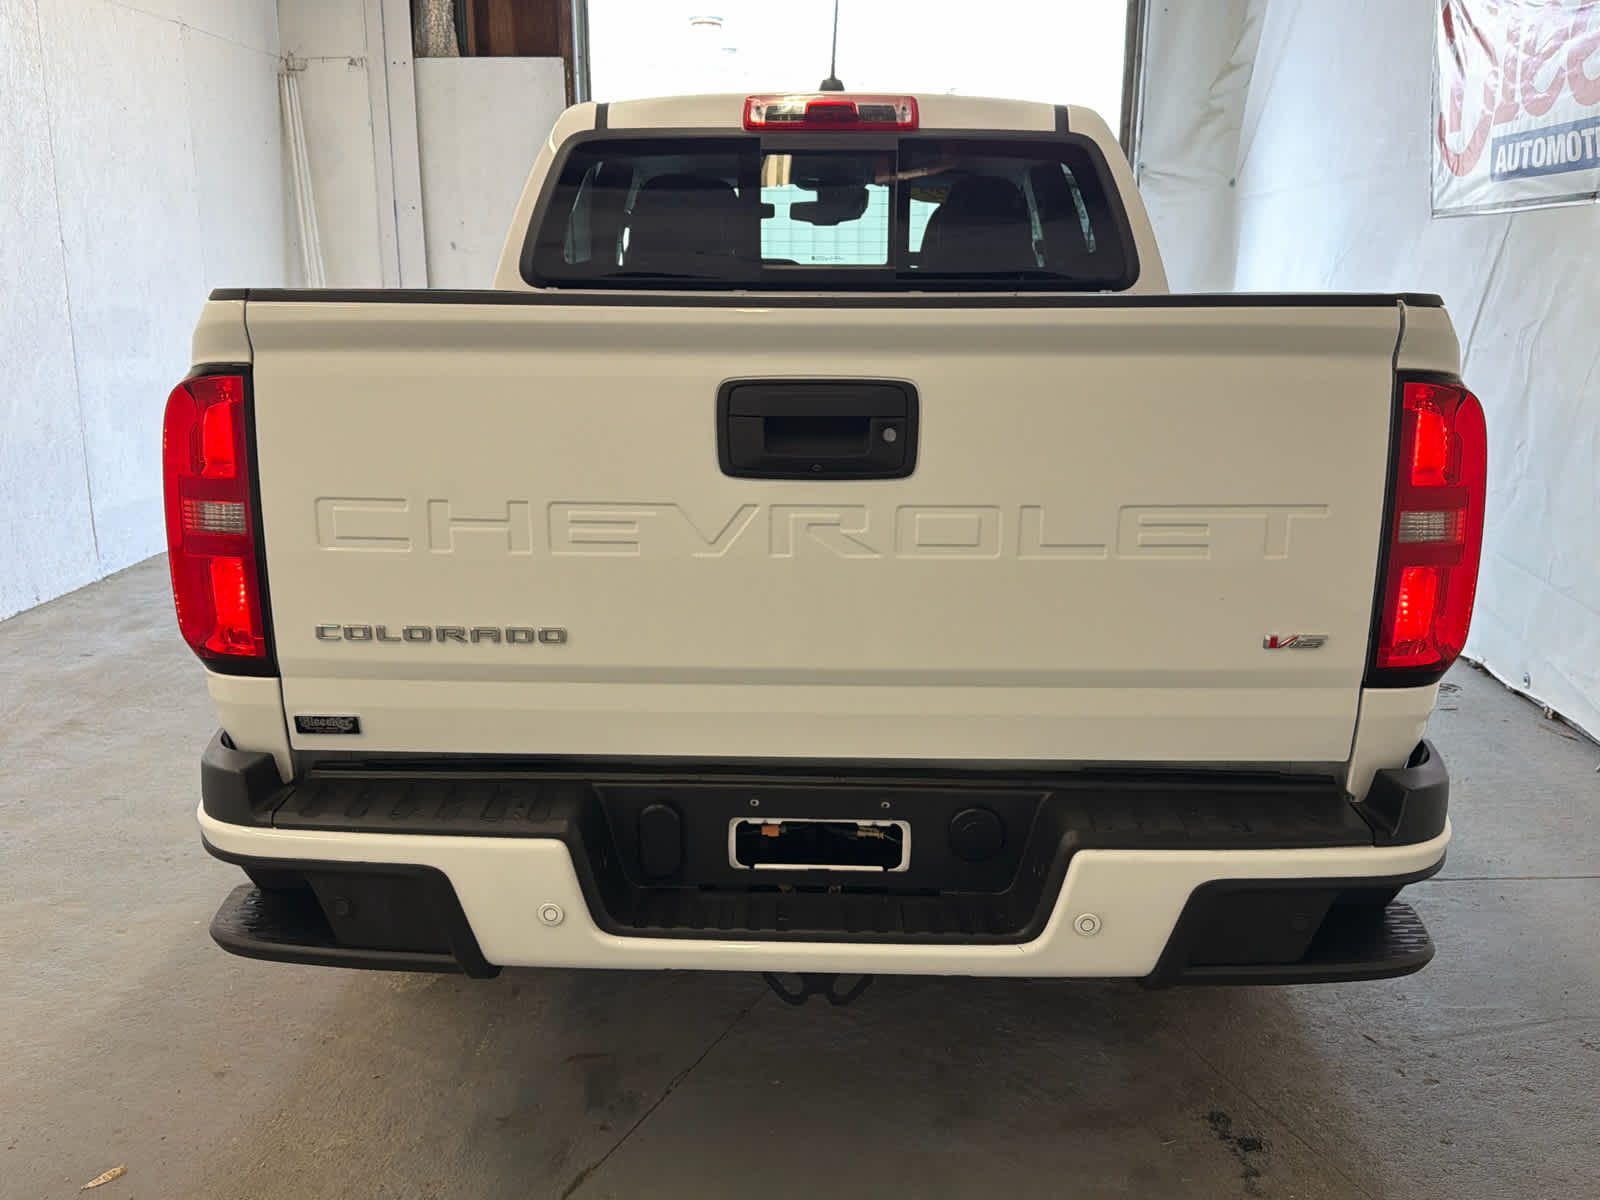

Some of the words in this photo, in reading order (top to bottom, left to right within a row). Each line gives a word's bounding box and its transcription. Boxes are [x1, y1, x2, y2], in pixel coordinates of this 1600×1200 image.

[314, 496, 1331, 561] CHEVROLET
[315, 623, 568, 644] COLORADO
[1263, 633, 1328, 648] V6
